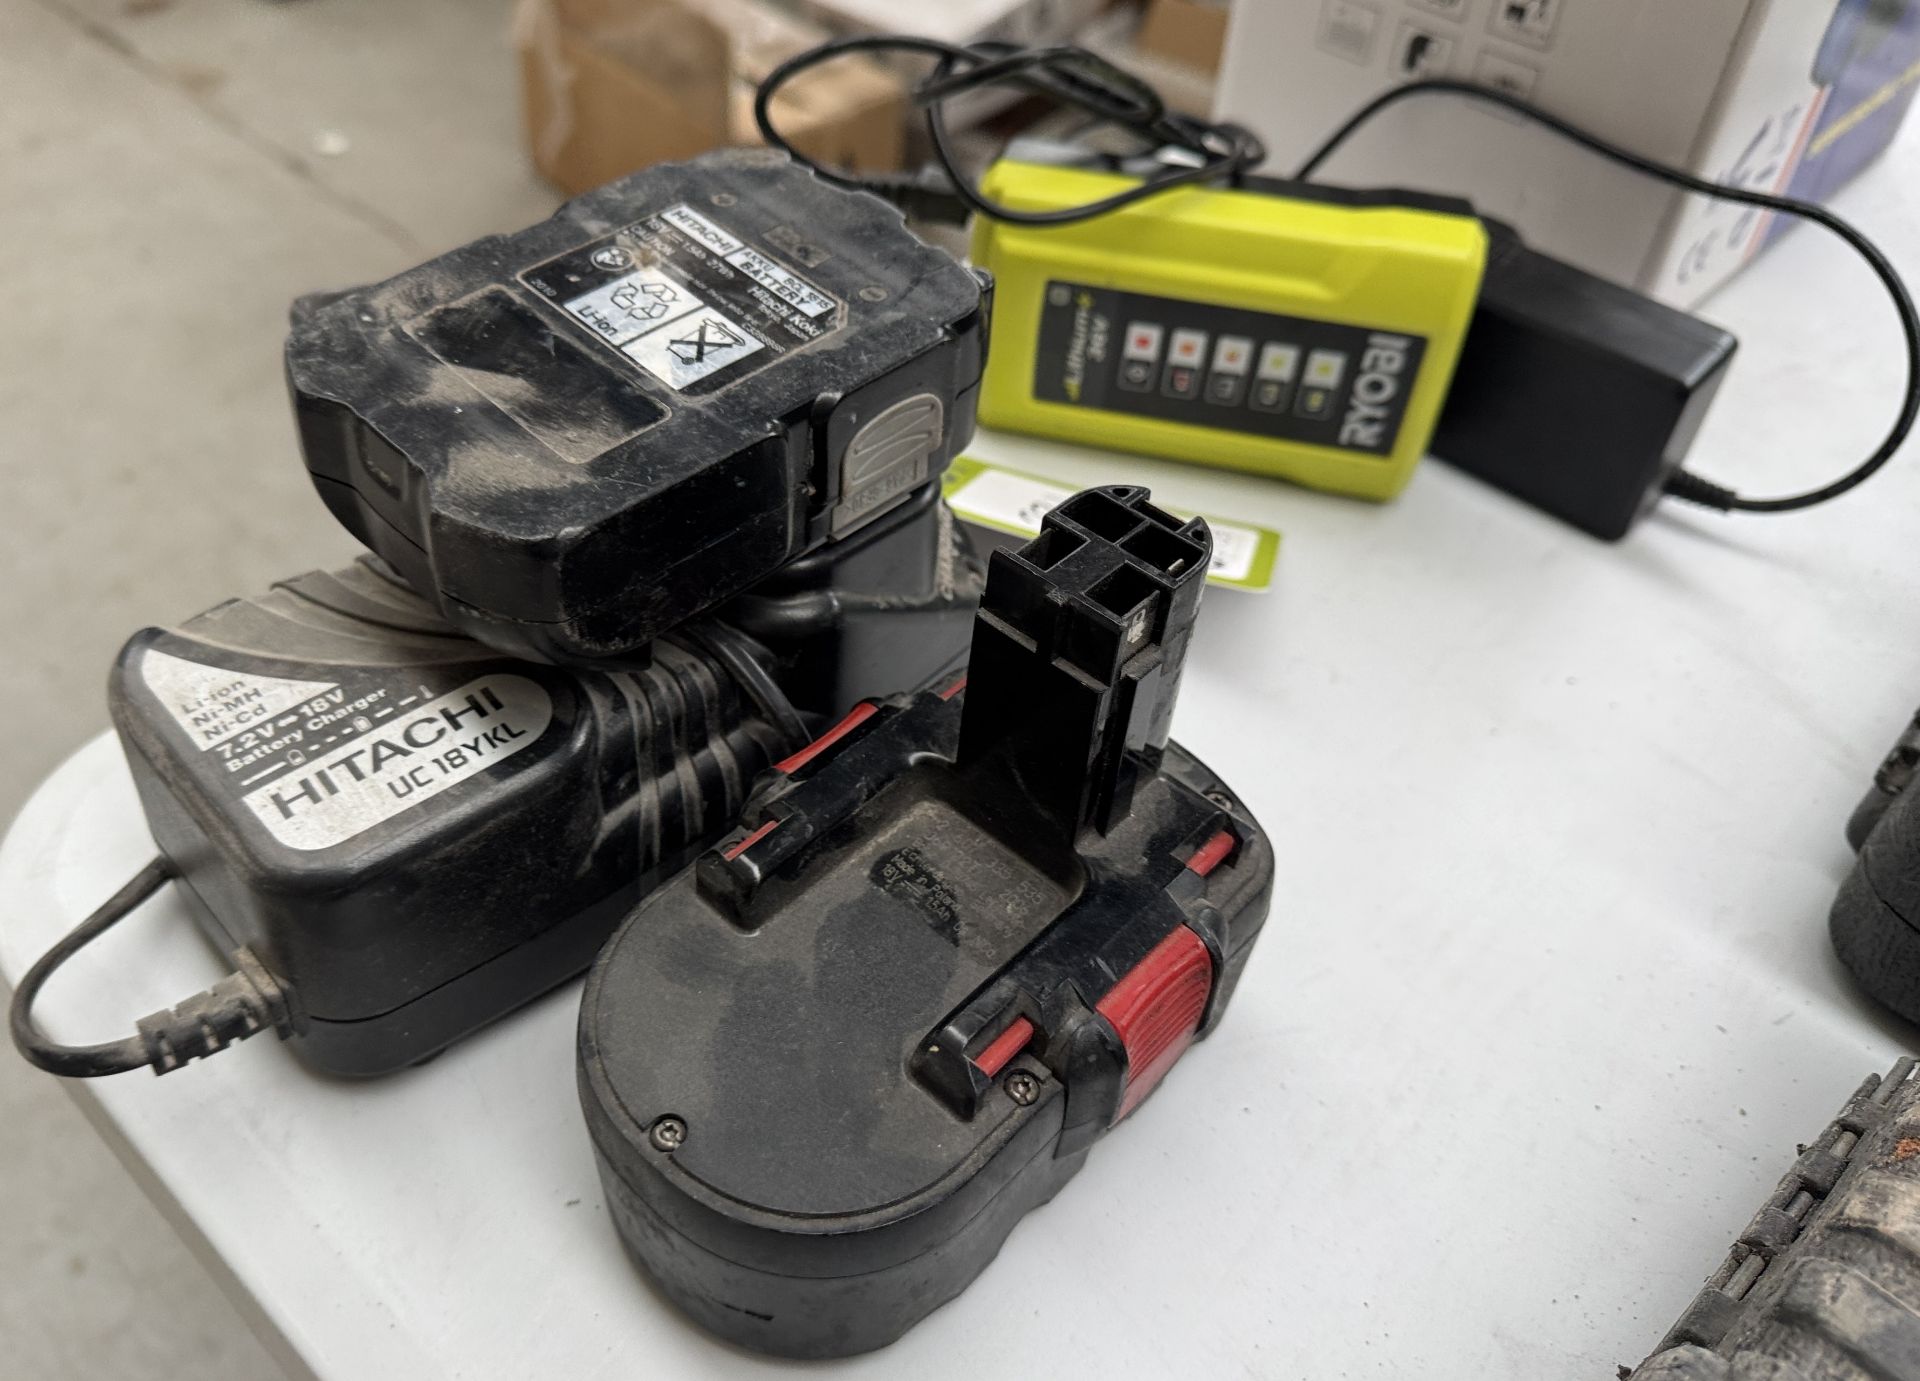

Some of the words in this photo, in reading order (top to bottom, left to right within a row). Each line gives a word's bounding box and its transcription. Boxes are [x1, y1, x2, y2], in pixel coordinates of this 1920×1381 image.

[671, 209, 735, 251] HITACHI
[740, 261, 811, 305] BATTERY
[743, 250, 775, 272] AKKU
[577, 305, 618, 337] Li-ion
[747, 285, 794, 318] Hitachi
[788, 314, 824, 338] Koki
[1338, 333, 1413, 448] RYOBI
[181, 678, 247, 714] Li-ion
[191, 687, 264, 727] Ni-MH
[203, 703, 268, 741] Ni-Cd
[215, 722, 276, 759] 7.2V
[299, 688, 345, 718] 18V
[224, 729, 304, 773] Battery
[306, 687, 388, 731] Charger
[269, 685, 505, 820] HITACHI
[386, 765, 434, 799] UC
[431, 721, 527, 775] 18YKL
[882, 862, 904, 884] 18V
[890, 852, 917, 877] Made
[915, 873, 929, 886] in
[930, 883, 963, 912] Poland
